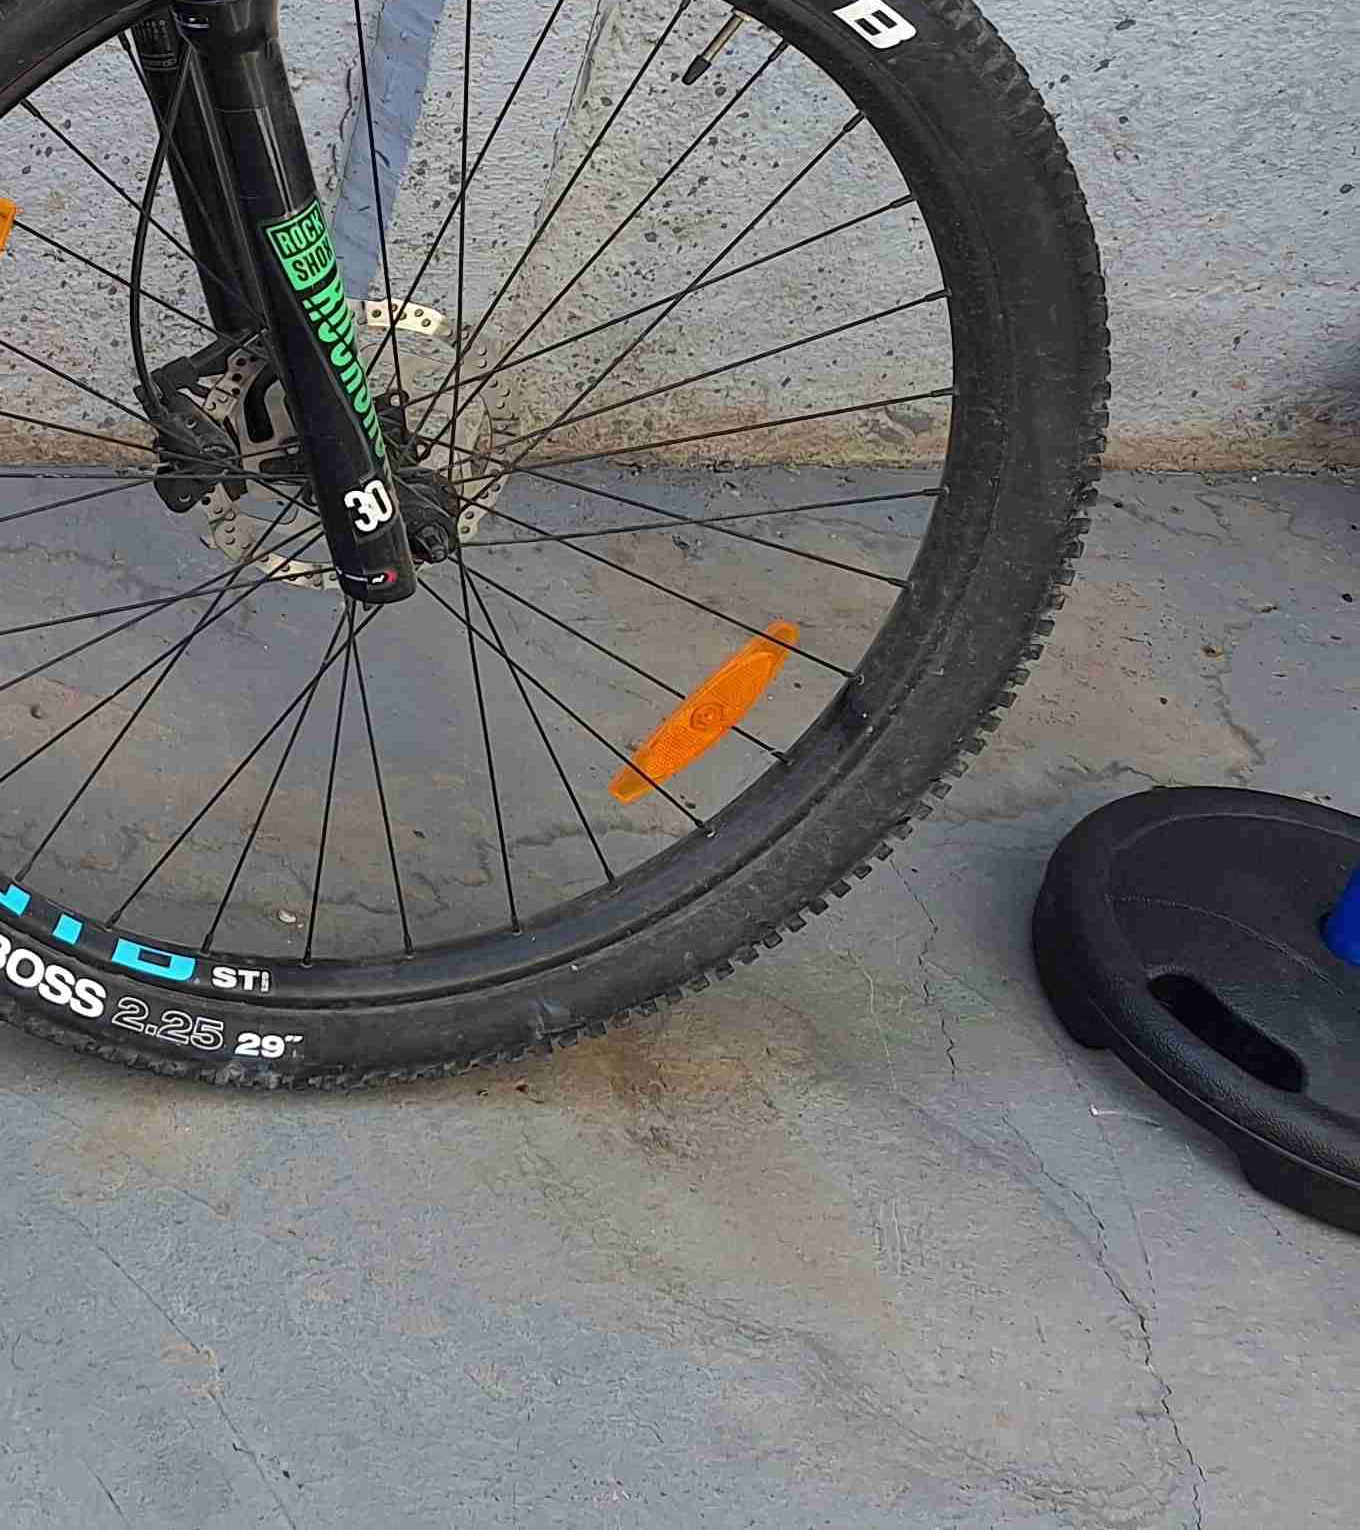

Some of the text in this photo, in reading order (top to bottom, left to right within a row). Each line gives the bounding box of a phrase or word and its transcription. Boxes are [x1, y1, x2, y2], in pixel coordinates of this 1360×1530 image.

[275, 210, 324, 255] ROCK
[344, 480, 393, 532] 30
[111, 996, 224, 1051] 2.25
